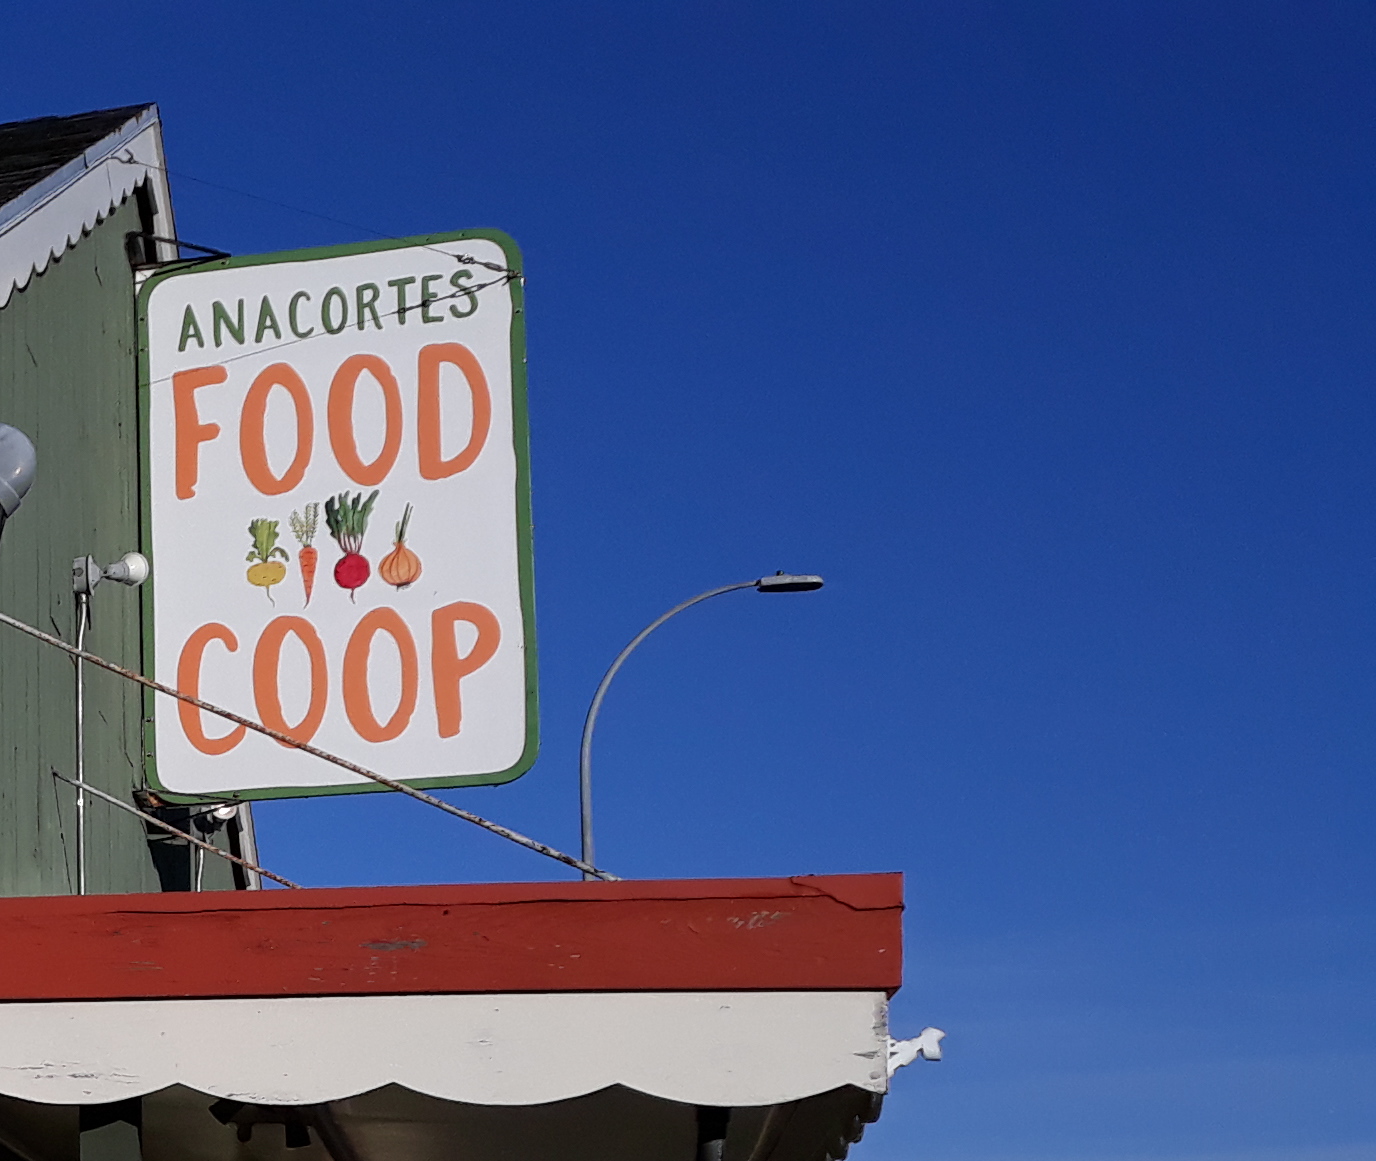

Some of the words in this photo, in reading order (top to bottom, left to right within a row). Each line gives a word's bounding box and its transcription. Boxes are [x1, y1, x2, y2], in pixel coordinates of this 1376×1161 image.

[177, 268, 479, 352] ANACORTES
[172, 342, 491, 500] FOOD
[176, 601, 501, 755] COOP
